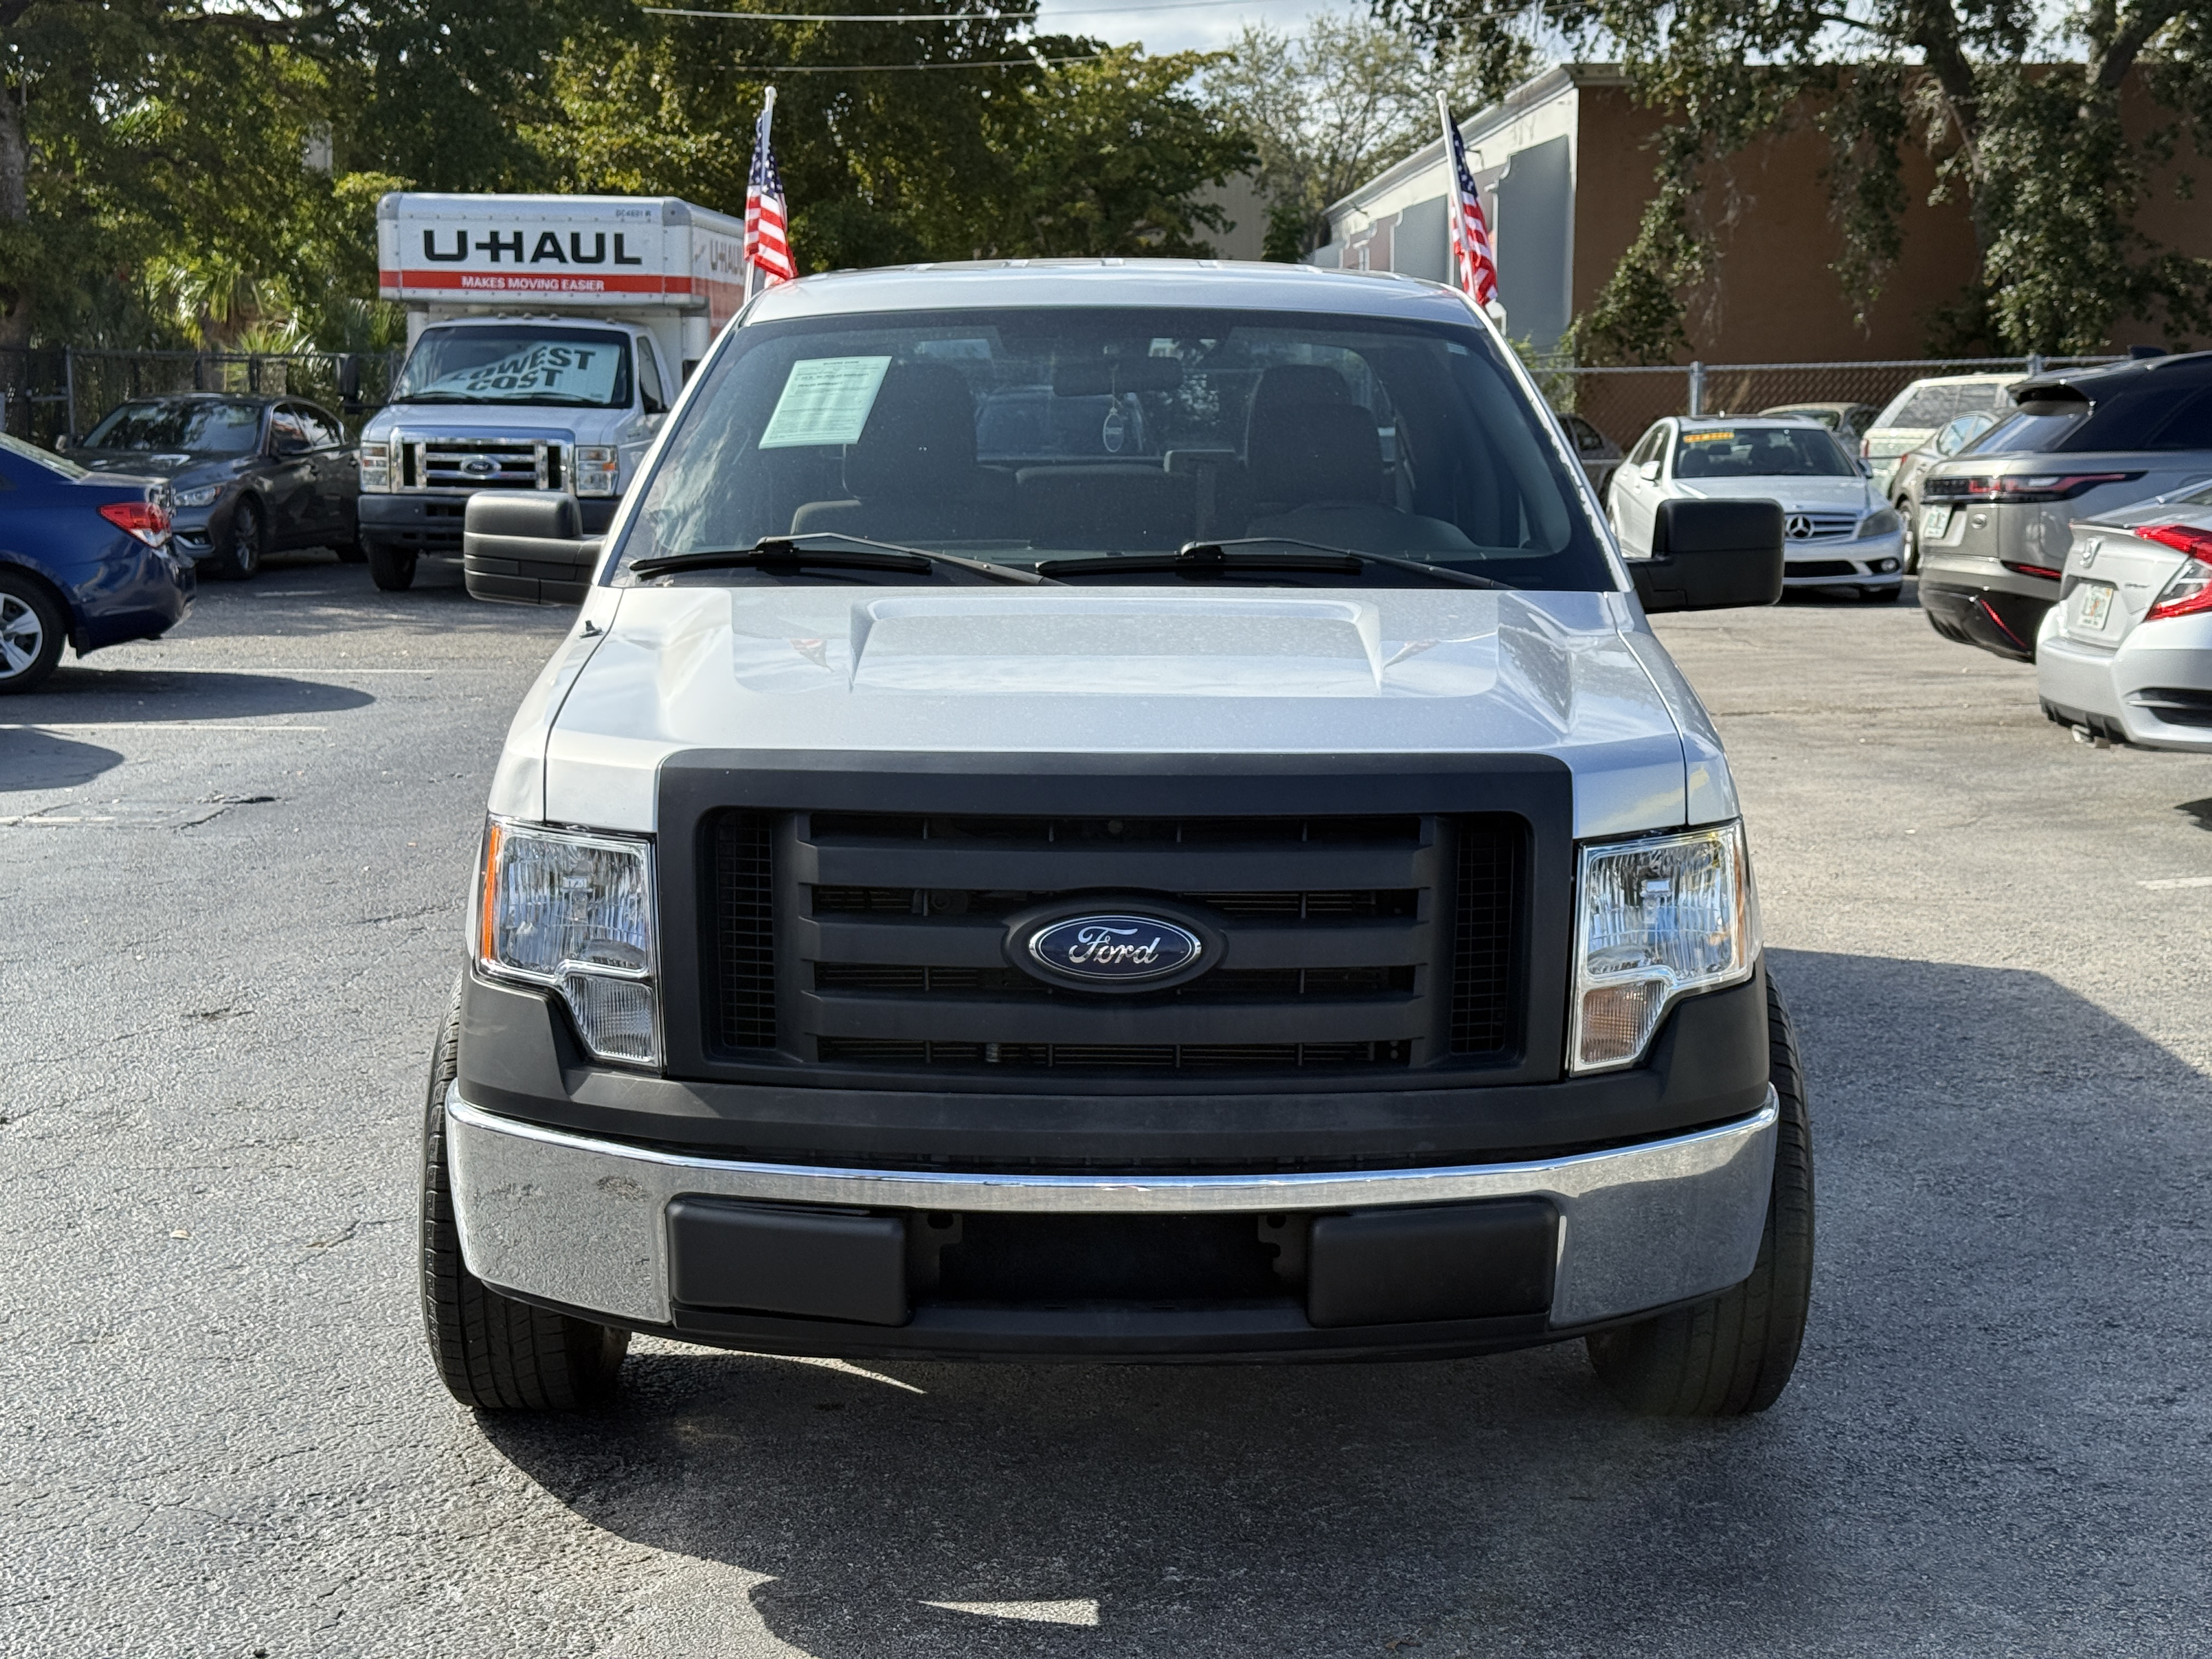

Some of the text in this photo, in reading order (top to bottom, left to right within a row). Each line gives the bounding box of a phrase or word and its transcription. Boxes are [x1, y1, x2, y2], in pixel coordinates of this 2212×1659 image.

[424, 230, 642, 265] U-HAUL
[461, 275, 605, 292] MAKES MOVING EASIER
[450, 346, 596, 380] LOWEST
[466, 367, 563, 391] COST
[1069, 926, 1161, 964] Ford
